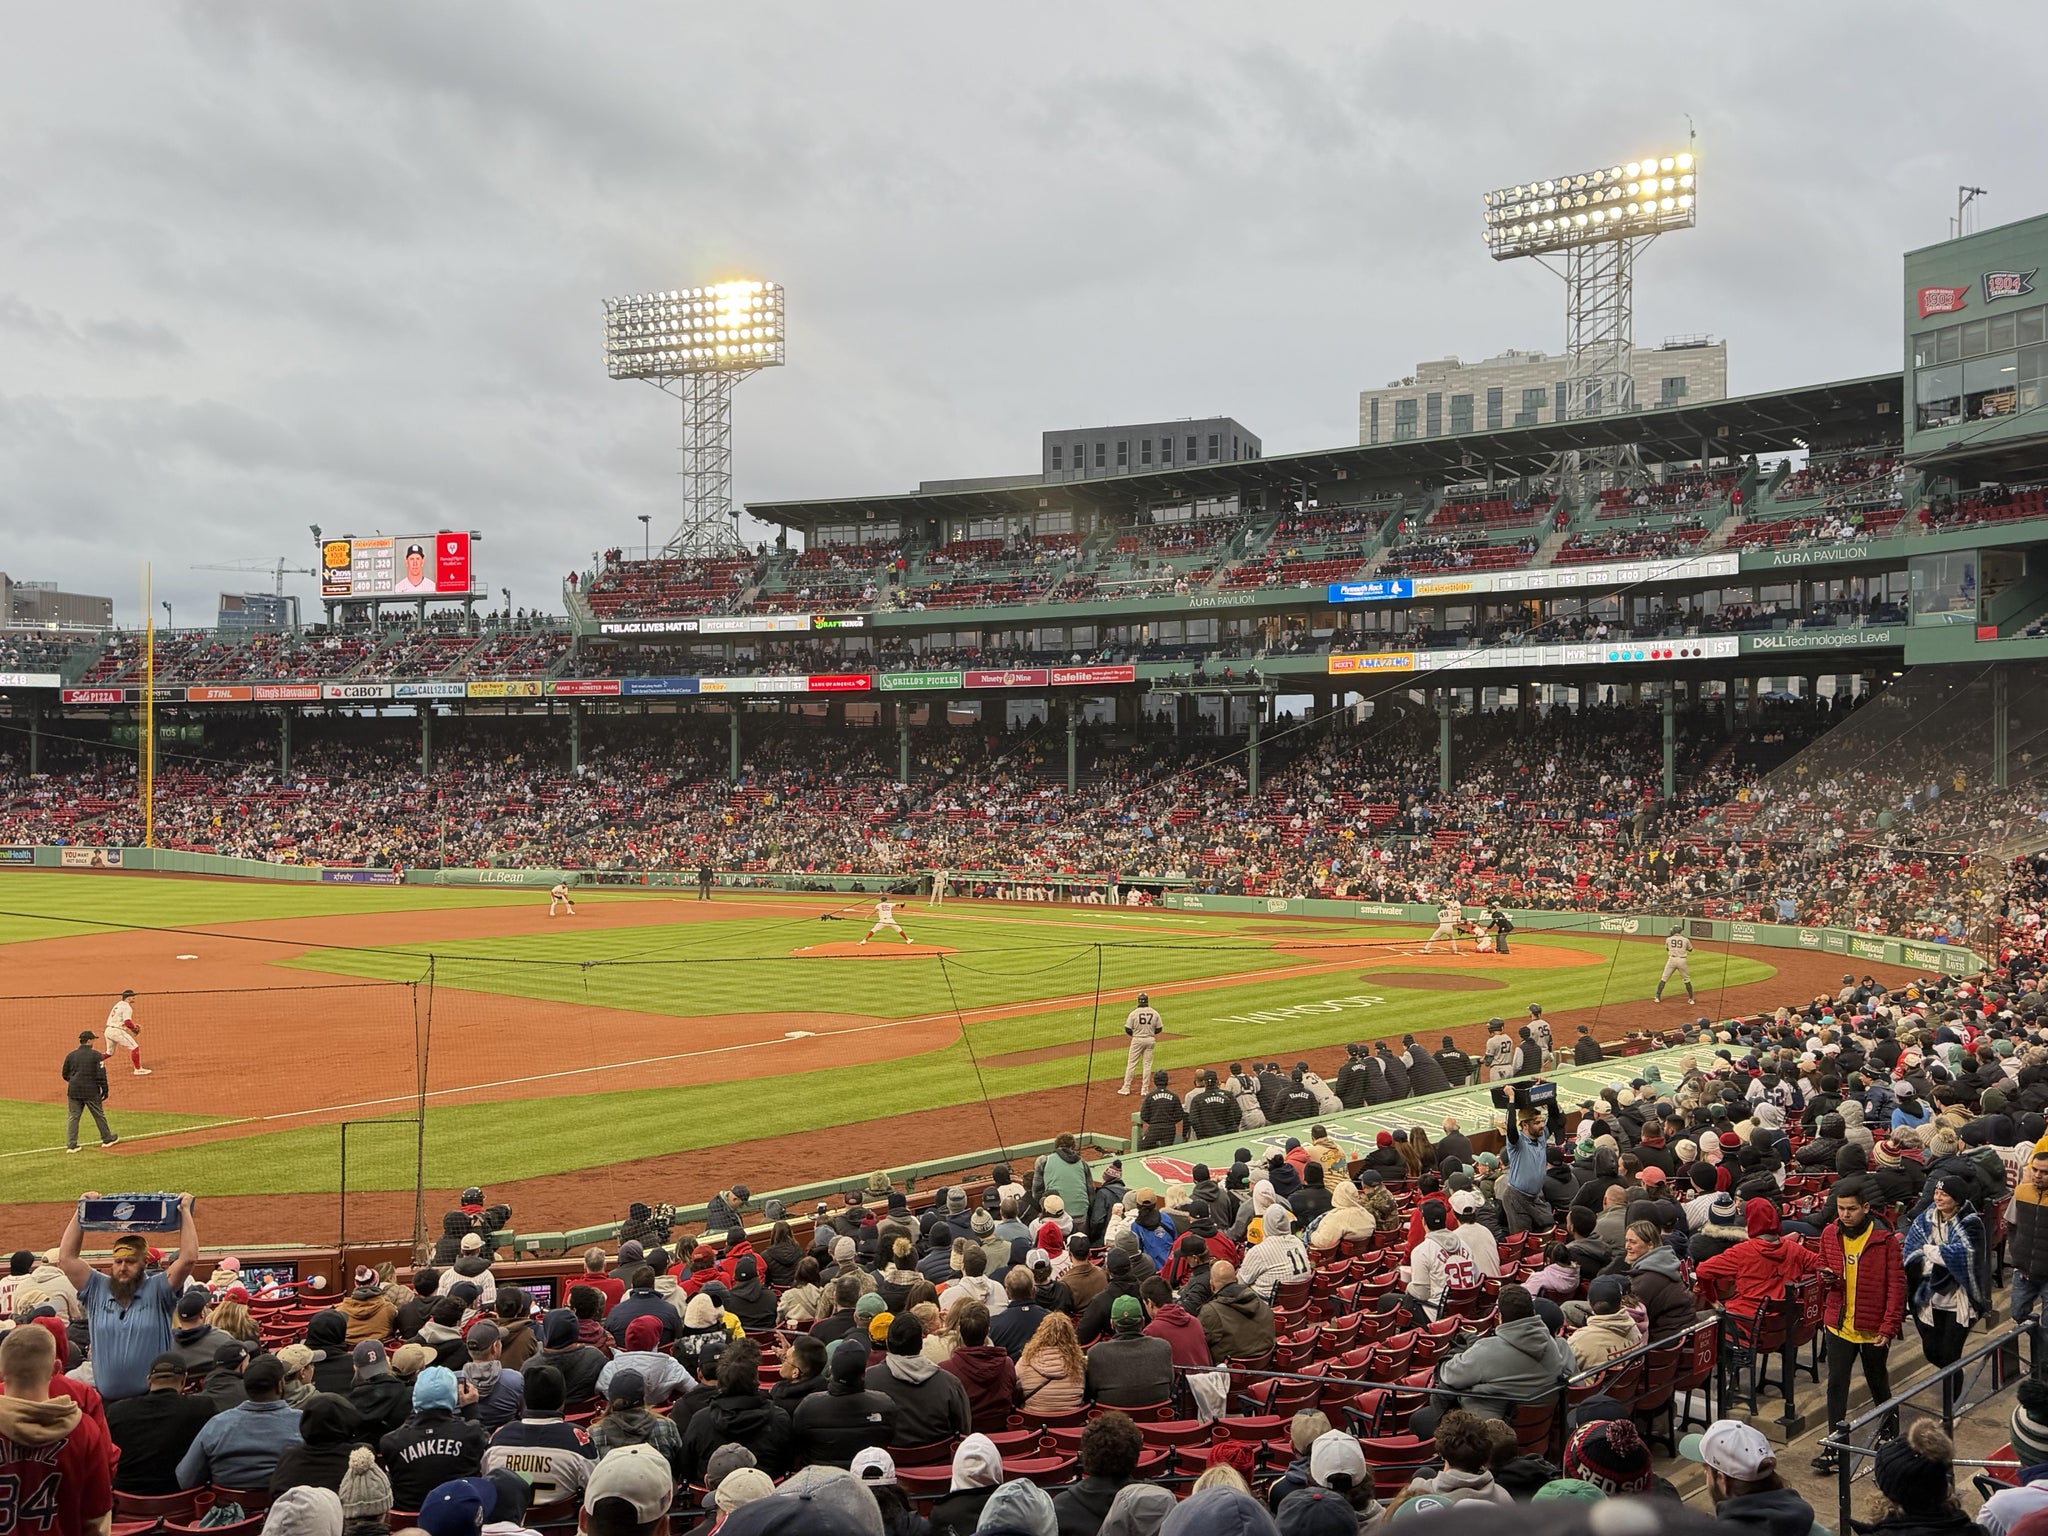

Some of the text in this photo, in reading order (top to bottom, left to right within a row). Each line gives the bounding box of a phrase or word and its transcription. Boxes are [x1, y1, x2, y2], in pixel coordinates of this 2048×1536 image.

[1988, 277, 2020, 291] 1904
[1925, 293, 1955, 307] 1903
[1814, 547, 1867, 562] PAVILION
[1417, 582, 1473, 594] GOLDSCHMIDT
[1534, 578, 1544, 586] 25
[1217, 594, 1255, 605] PAVILION
[614, 621, 698, 633] BLACK LIVES MATTER
[1649, 641, 1675, 650] STRIKE
[1684, 640, 1698, 648] OUT
[1753, 630, 1890, 648] DELL Technologies Level
[1567, 650, 1585, 660] MVR
[1358, 656, 1410, 668] AMAZING
[926, 676, 958, 684] PICKLES
[981, 675, 1002, 684] Ninety
[1054, 673, 1092, 682] Safelite
[207, 690, 232, 698] STIHL
[256, 687, 318, 700] King's Hawaiian
[418, 685, 463, 695] CALL128.COM
[71, 691, 114, 702] Sal's PIZZA
[138, 728, 177, 738] HOITOS
[334, 872, 354, 881] xfinity
[479, 872, 524, 882] L.L.Bean
[1360, 905, 1404, 916] smartwater
[1600, 922, 1622, 931] Nine
[1670, 939, 1684, 948] 99
[1860, 940, 1884, 954] National
[1914, 950, 1940, 964] National
[1211, 996, 1387, 1024] WHOOP
[1138, 1012, 1154, 1025] 67
[1538, 1024, 1550, 1038] 35
[1501, 1040, 1512, 1054] 27
[1152, 1092, 1174, 1101] YANKEES
[1204, 1096, 1224, 1104] YANKEES
[1764, 1088, 1785, 1107] 52
[1286, 1248, 1308, 1276] 11
[1444, 1261, 1474, 1289] 35
[1806, 1304, 1819, 1318] 69
[368, 1350, 377, 1362] B
[1697, 1350, 1712, 1366] 70
[400, 1438, 463, 1464] YANKEES
[506, 1454, 552, 1473] BRUINS
[0, 1472, 62, 1535] 34
